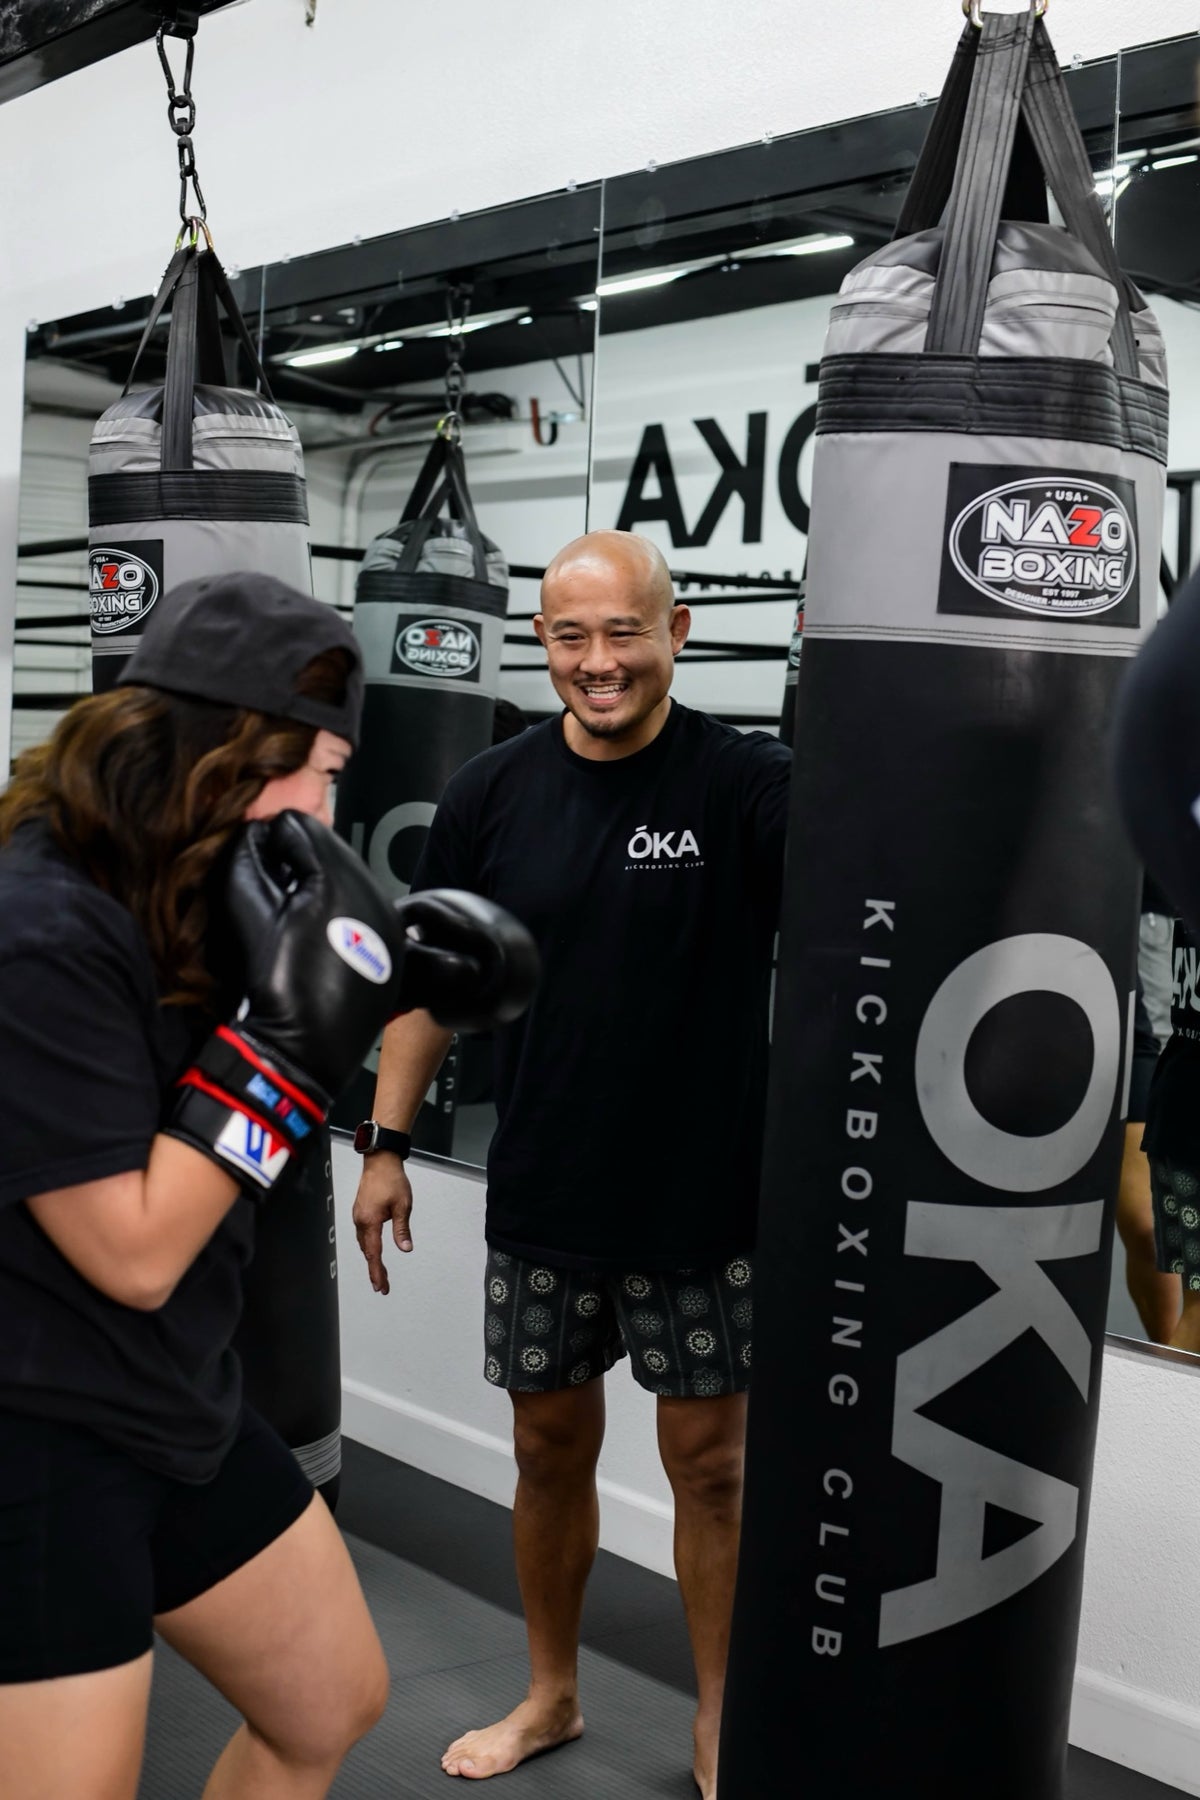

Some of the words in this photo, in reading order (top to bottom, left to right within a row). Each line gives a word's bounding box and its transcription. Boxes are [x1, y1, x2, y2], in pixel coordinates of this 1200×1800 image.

[1055, 490, 1082, 502] USA
[983, 500, 1127, 551] NAZO
[90, 563, 145, 591] AZO
[982, 548, 1124, 588] BOXING
[90, 592, 142, 615] OXING
[1004, 588, 1049, 605] DESIGNER
[1042, 588, 1060, 597] EST
[1061, 589, 1080, 599] 1997
[828, 899, 896, 1406] KICKBOXING
[811, 1468, 853, 1657] CLUB
